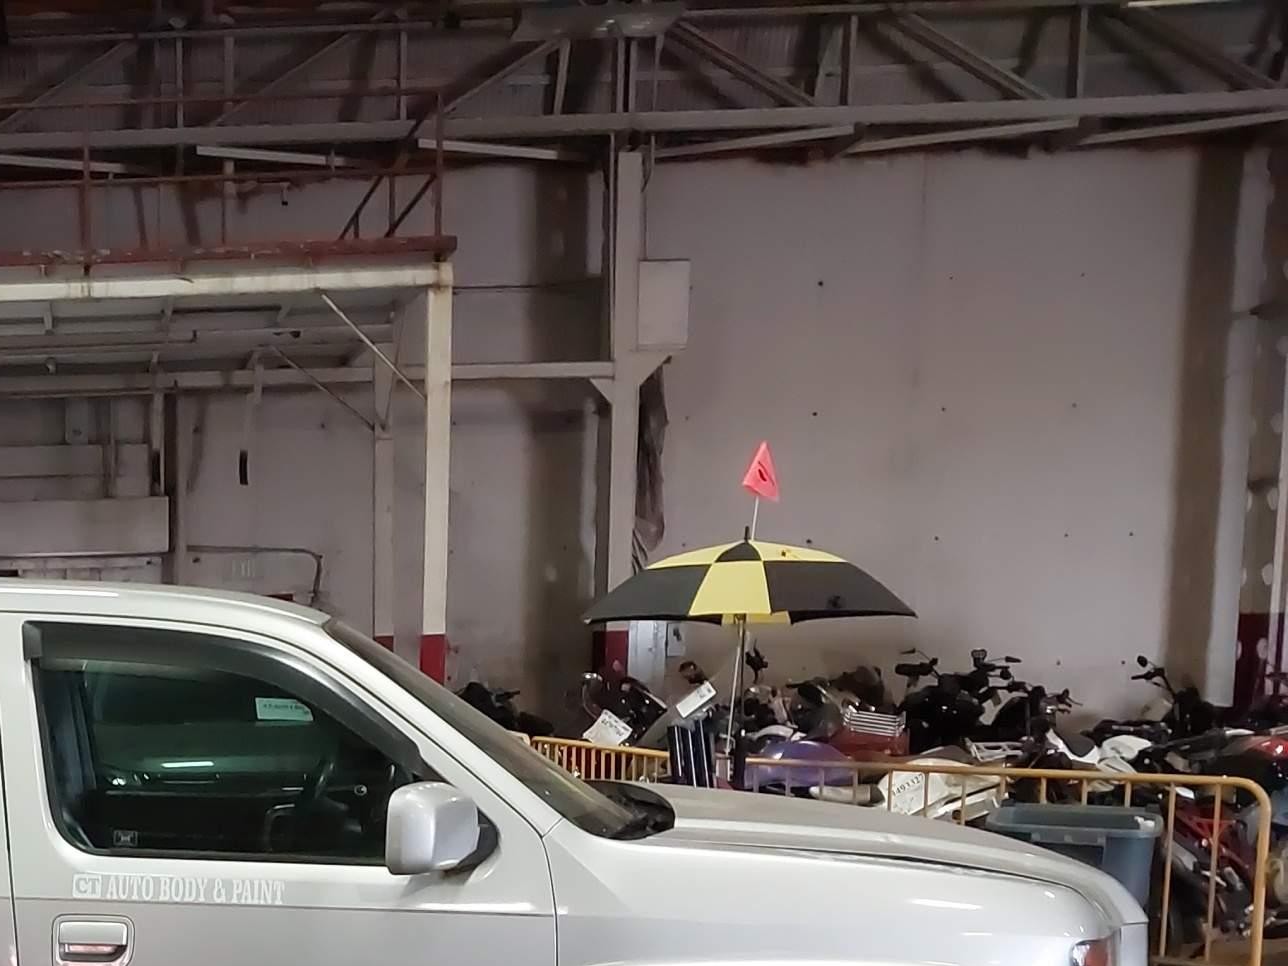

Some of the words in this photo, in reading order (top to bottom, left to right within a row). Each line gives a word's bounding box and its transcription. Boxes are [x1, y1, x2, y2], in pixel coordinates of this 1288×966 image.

[74, 876, 101, 897] CT
[106, 875, 153, 900] AUTO
[159, 876, 207, 902] BODY
[213, 878, 226, 903] &
[231, 879, 285, 905] PAINT
